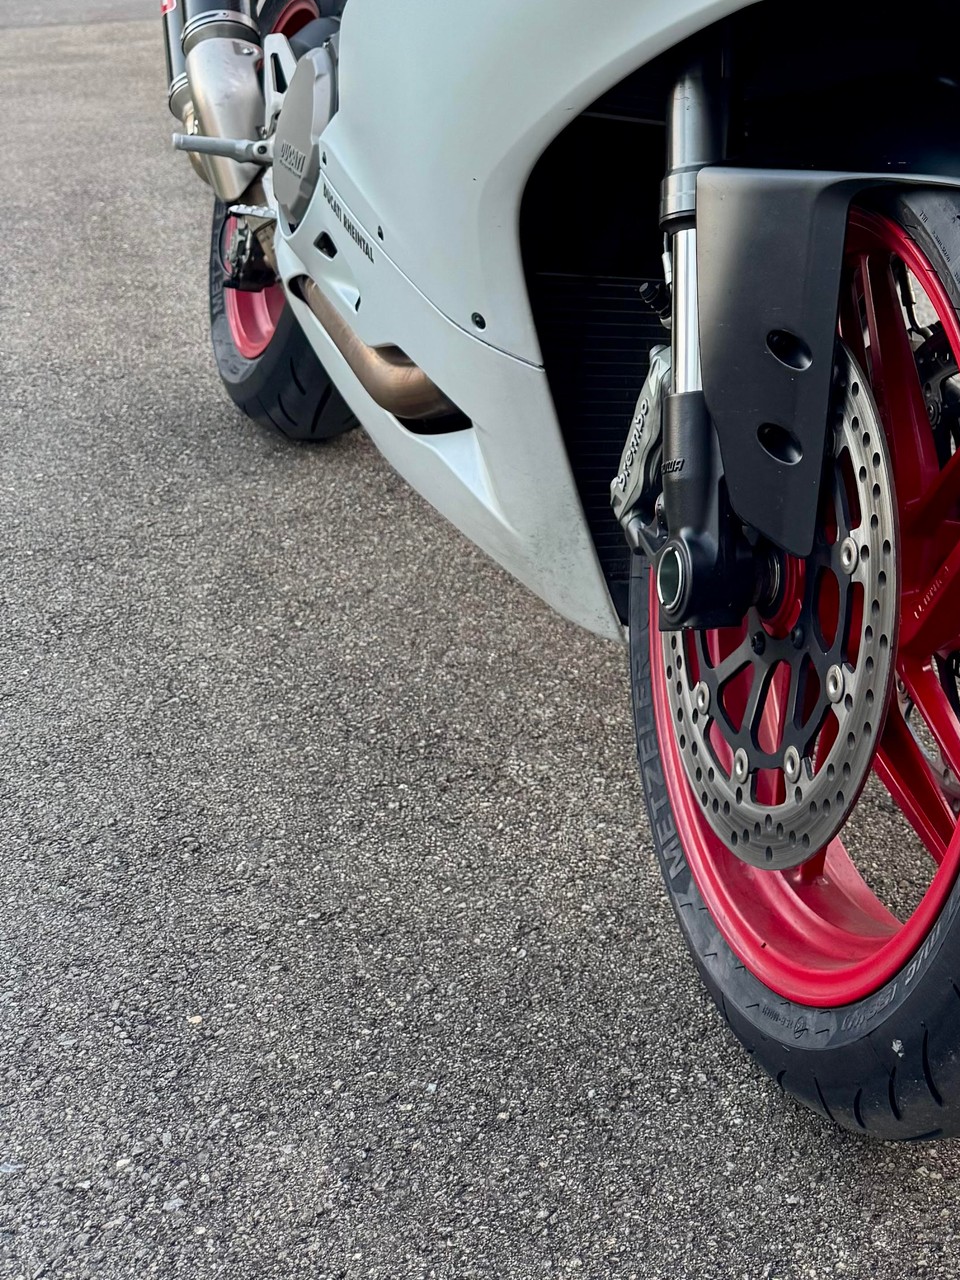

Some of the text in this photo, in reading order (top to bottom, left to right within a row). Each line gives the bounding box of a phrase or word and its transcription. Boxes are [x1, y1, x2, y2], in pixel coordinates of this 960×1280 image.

[281, 142, 306, 173] DUCATI
[323, 182, 375, 264] DUCATI RHEINTAL
[618, 398, 649, 493] brembo
